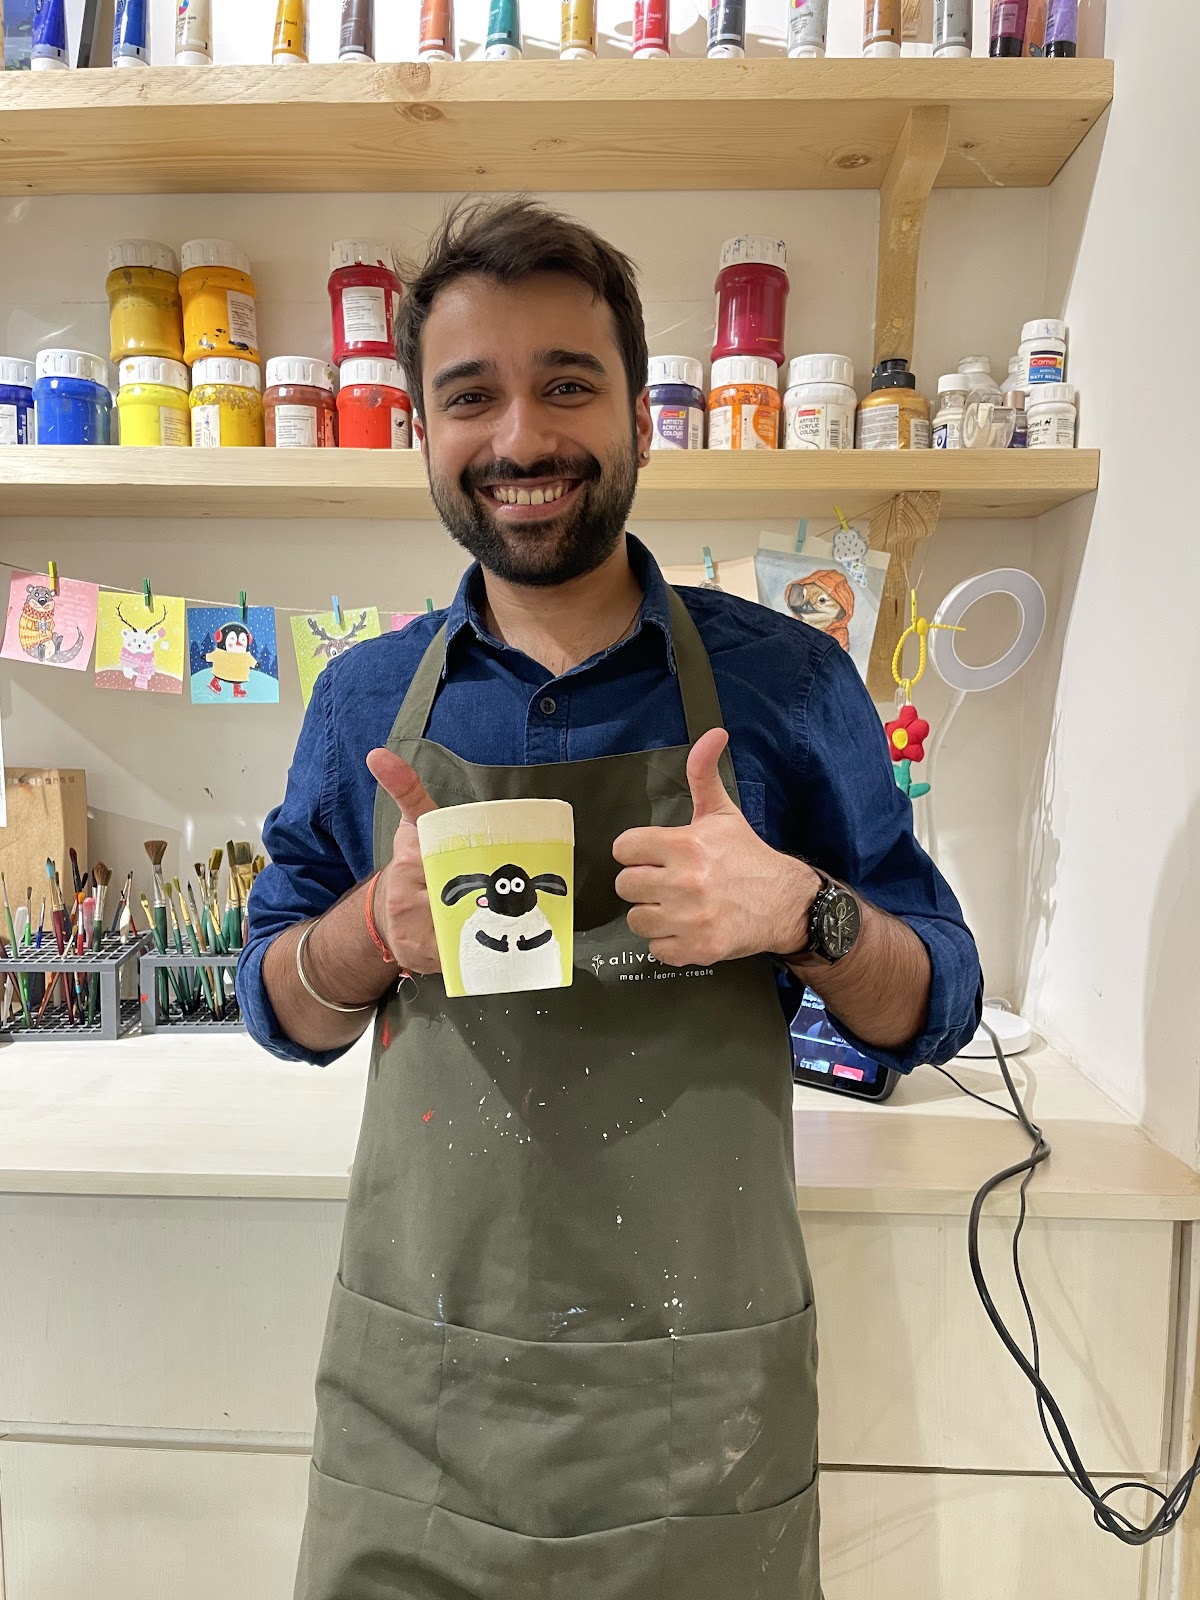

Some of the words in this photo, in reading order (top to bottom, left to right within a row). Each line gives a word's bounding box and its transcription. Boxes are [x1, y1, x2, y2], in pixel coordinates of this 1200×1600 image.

[799, 428, 820, 436] COLOUR
[619, 973, 644, 981] meet
[653, 970, 676, 980] learn
[685, 968, 714, 977] create
